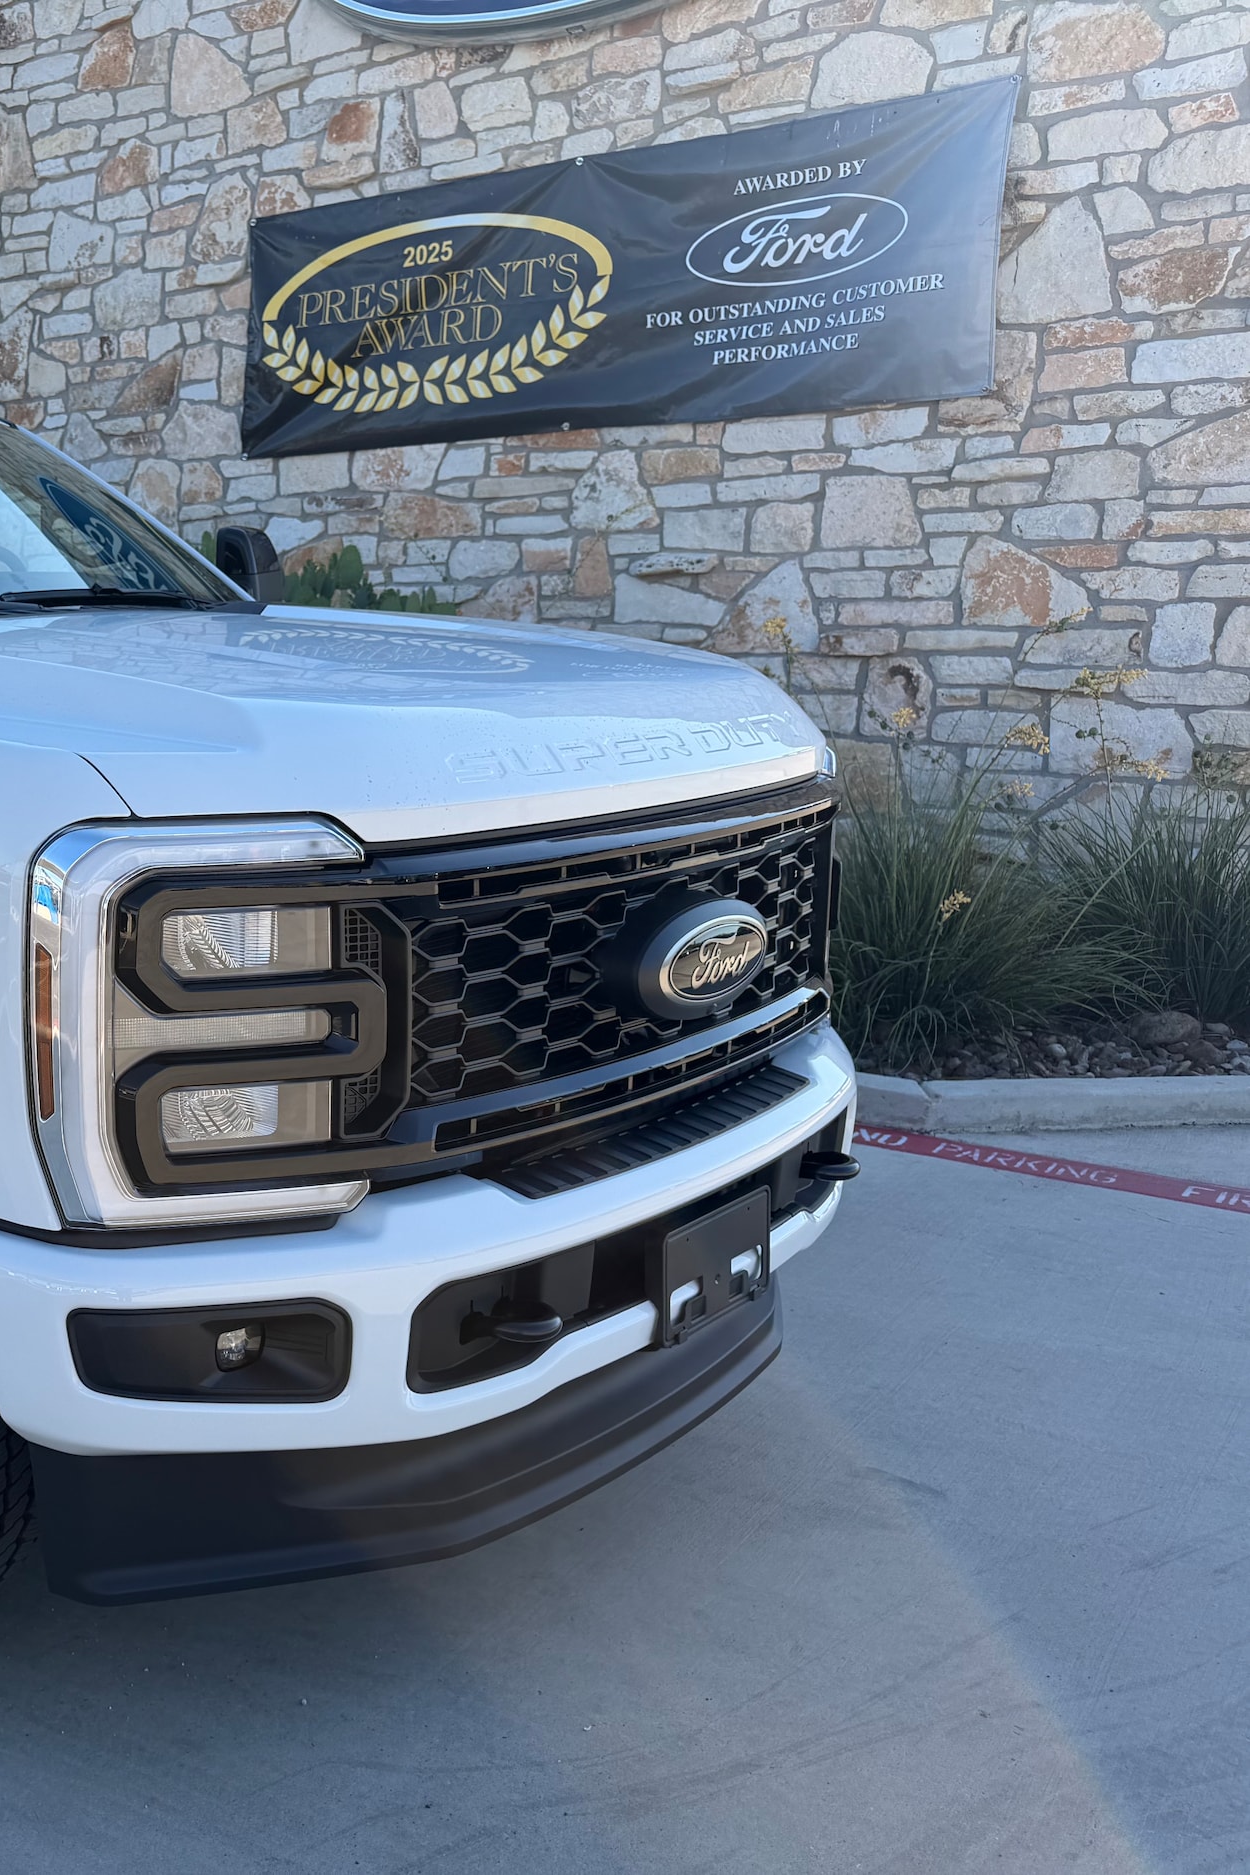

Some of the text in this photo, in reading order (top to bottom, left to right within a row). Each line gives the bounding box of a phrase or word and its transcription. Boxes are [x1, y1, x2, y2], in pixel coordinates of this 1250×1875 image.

[733, 158, 868, 196] AWARDED BY
[402, 240, 454, 268] 2025
[722, 205, 868, 274] Ford
[296, 252, 579, 328] PRESIDENT'S
[645, 272, 946, 329] FOR OUTSTANDING CUSTOMER
[351, 303, 503, 358] AWARD
[693, 304, 886, 347] SERVICE AND SALES
[711, 332, 860, 366] PERFORMANCE
[444, 710, 801, 785] SUPER DUTY
[691, 932, 750, 989] Ford
[852, 1127, 909, 1147] NO
[932, 1141, 1118, 1184] PARKING
